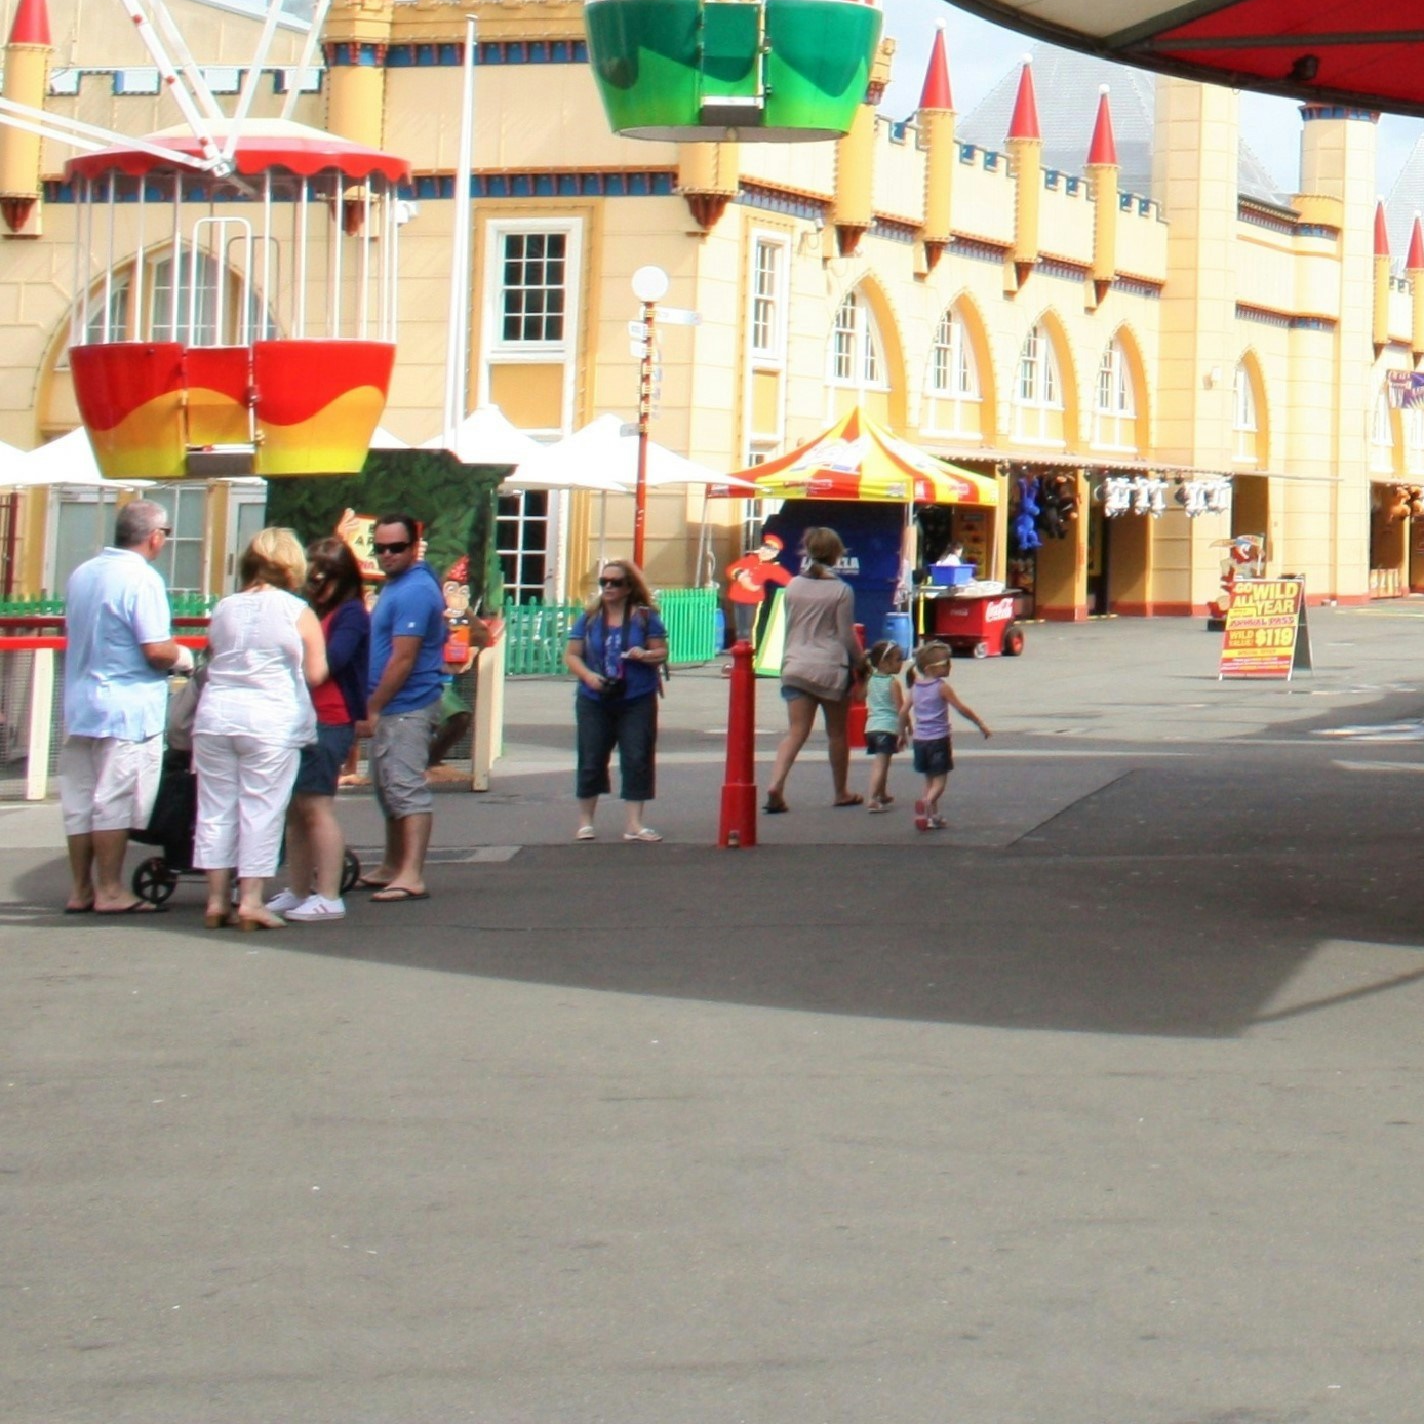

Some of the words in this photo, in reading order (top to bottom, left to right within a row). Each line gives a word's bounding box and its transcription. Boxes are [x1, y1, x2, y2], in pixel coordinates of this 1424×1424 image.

[1235, 582, 1253, 593] GO
[1253, 582, 1297, 599] WILD
[1233, 595, 1256, 607] ALL
[1255, 599, 1295, 616] YEAR
